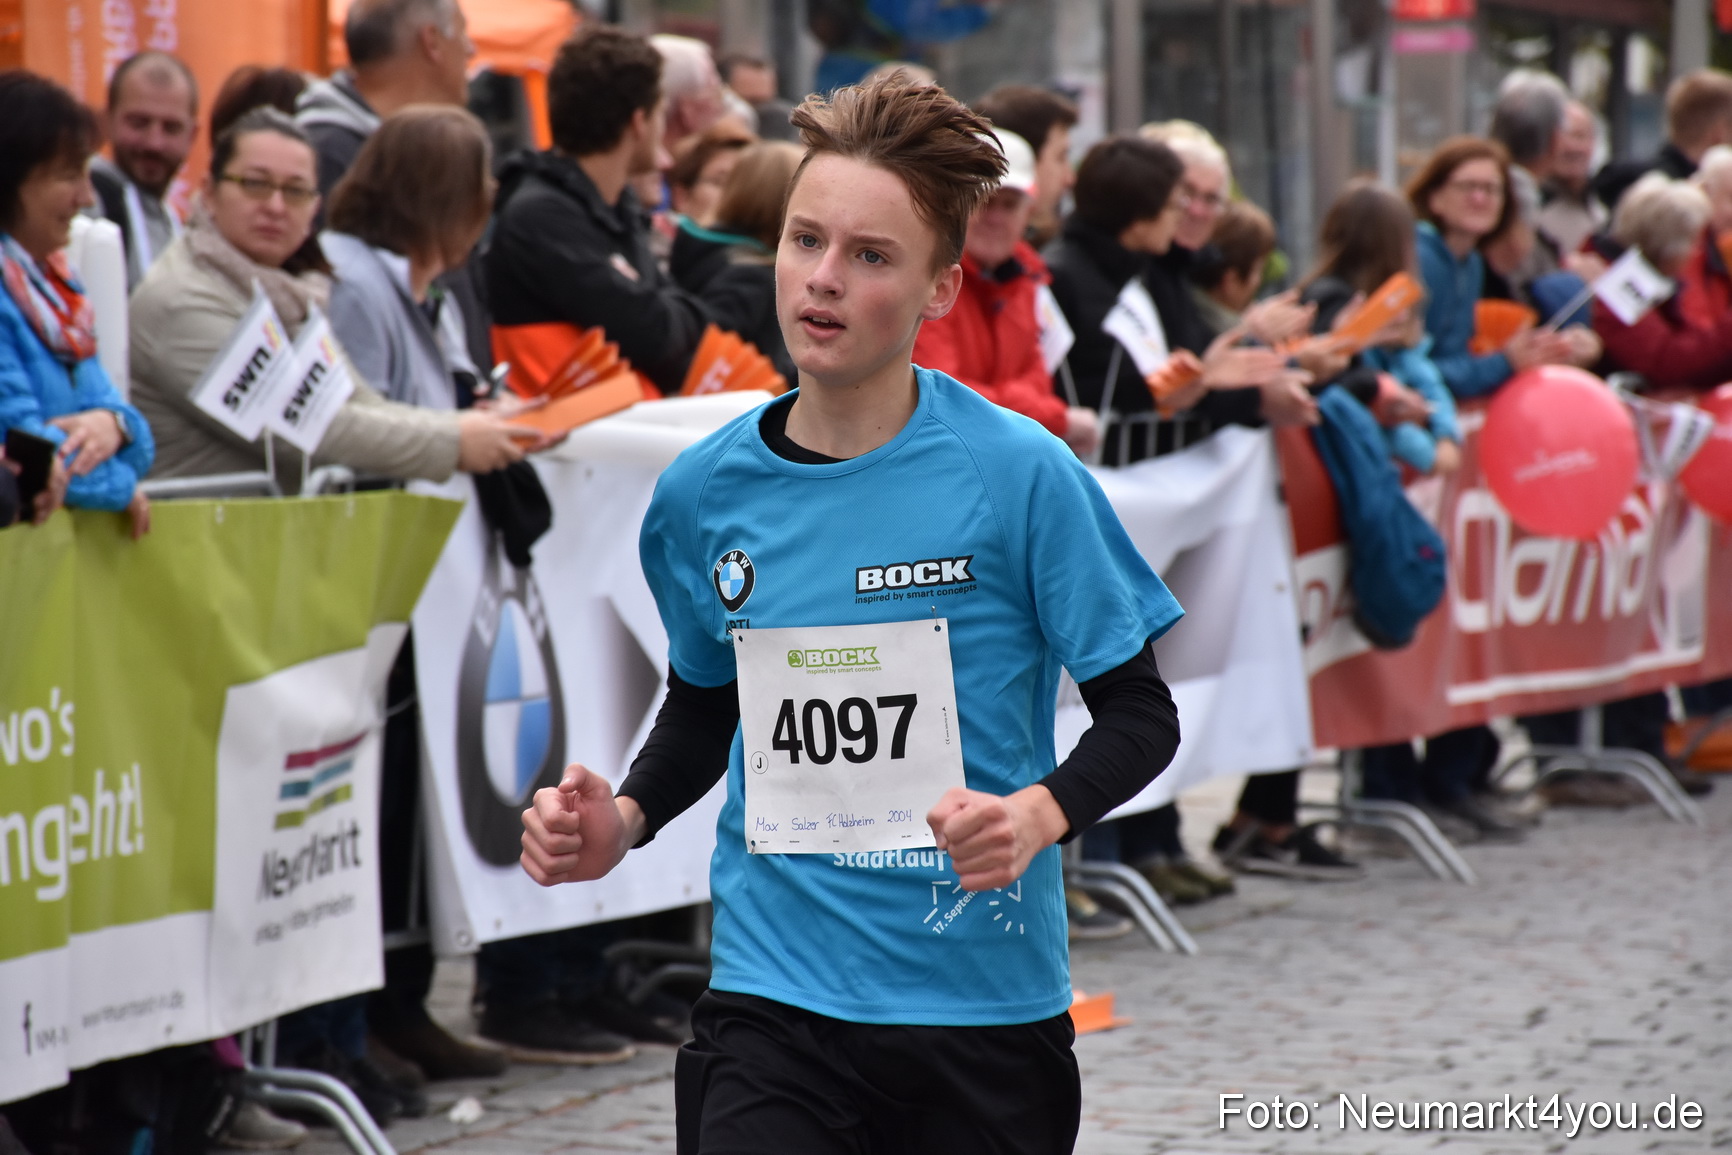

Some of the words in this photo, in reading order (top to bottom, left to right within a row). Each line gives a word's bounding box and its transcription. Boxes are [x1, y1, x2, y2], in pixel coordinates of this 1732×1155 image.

[222, 346, 271, 413] swn
[283, 361, 328, 428] swn
[715, 551, 751, 573] BMW
[856, 555, 976, 594] BOCK
[855, 592, 890, 604] inspired
[893, 592, 905, 602] by
[906, 589, 935, 599] smart
[936, 583, 978, 596] concepts
[805, 646, 880, 667] BOCK
[854, 665, 882, 673] concepts
[772, 693, 918, 765] 4097
[755, 816, 779, 832] Max
[887, 809, 913, 823] 2004
[932, 920, 949, 935] 17.
